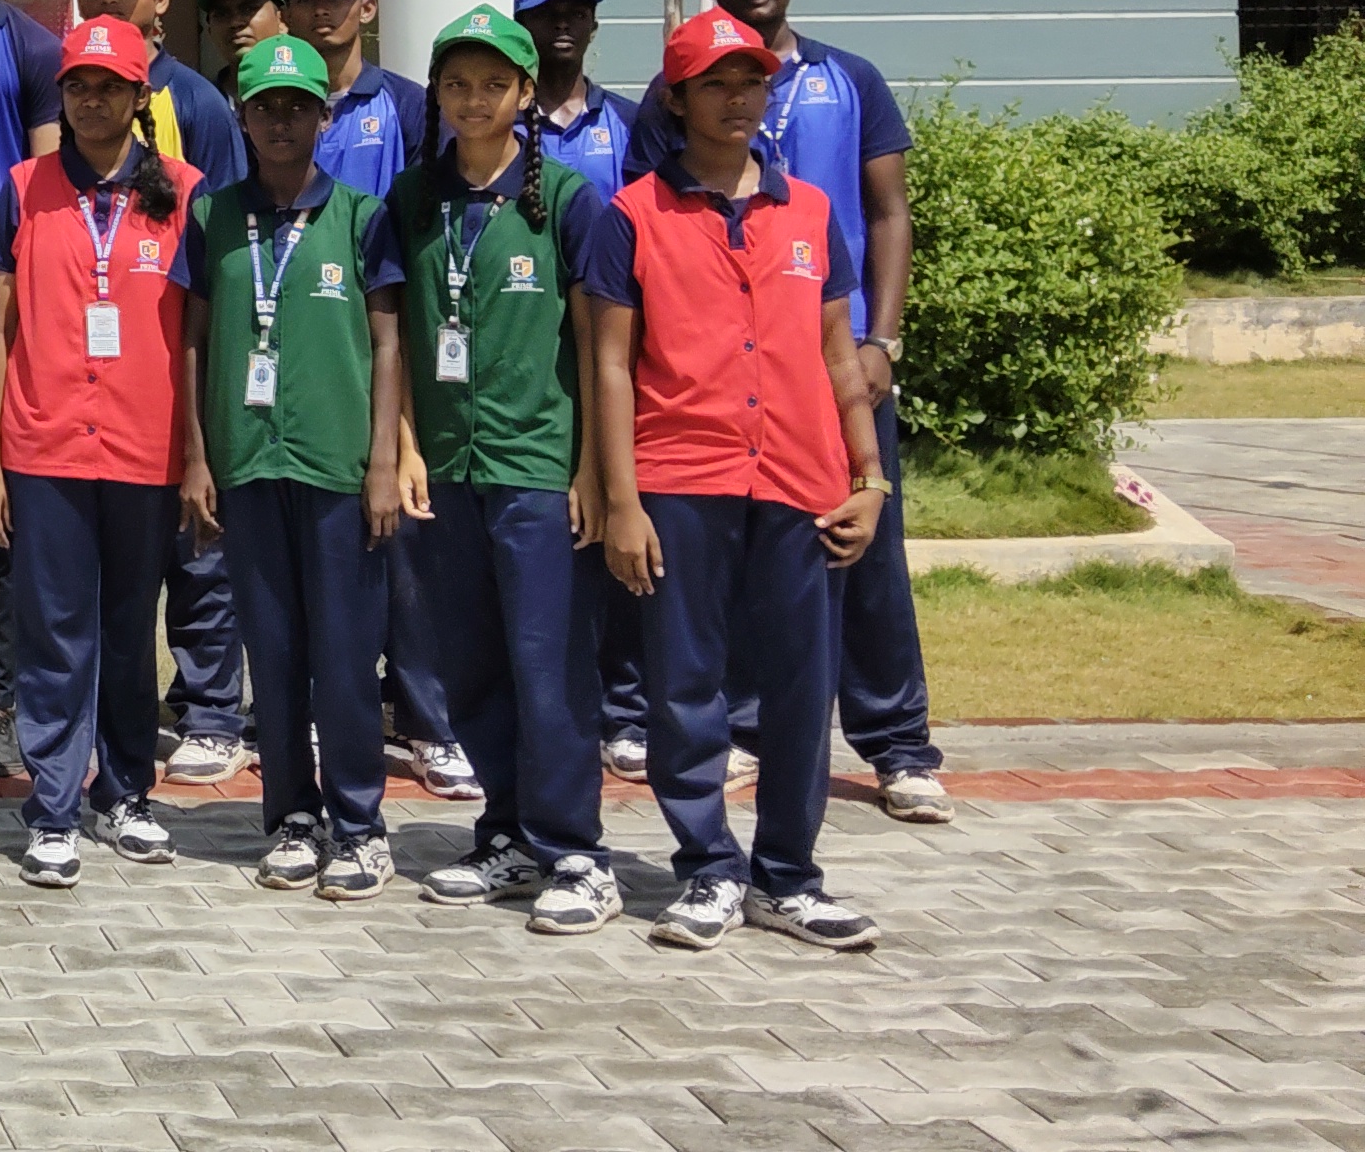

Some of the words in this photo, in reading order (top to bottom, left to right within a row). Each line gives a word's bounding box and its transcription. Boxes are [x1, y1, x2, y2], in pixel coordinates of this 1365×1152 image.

[463, 28, 492, 36] PRIME
[85, 45, 112, 53] PRIME
[270, 65, 298, 73] PRIME
